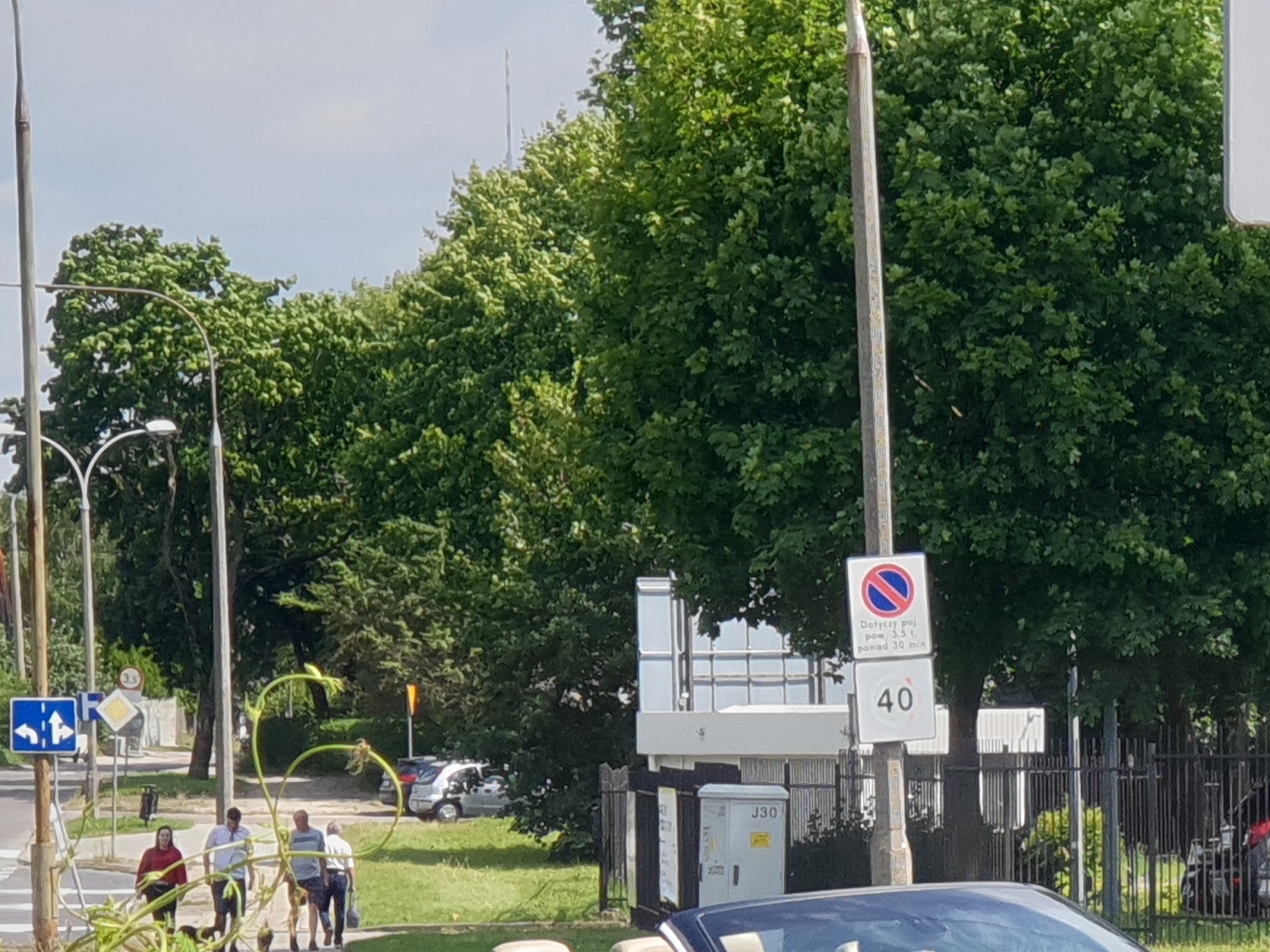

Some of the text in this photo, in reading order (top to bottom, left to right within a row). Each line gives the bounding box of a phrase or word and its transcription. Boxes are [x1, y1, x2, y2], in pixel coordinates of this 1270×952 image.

[857, 639, 888, 654] ponad
[892, 640, 905, 650] 30
[877, 686, 913, 713] 40
[751, 806, 778, 819] J30
